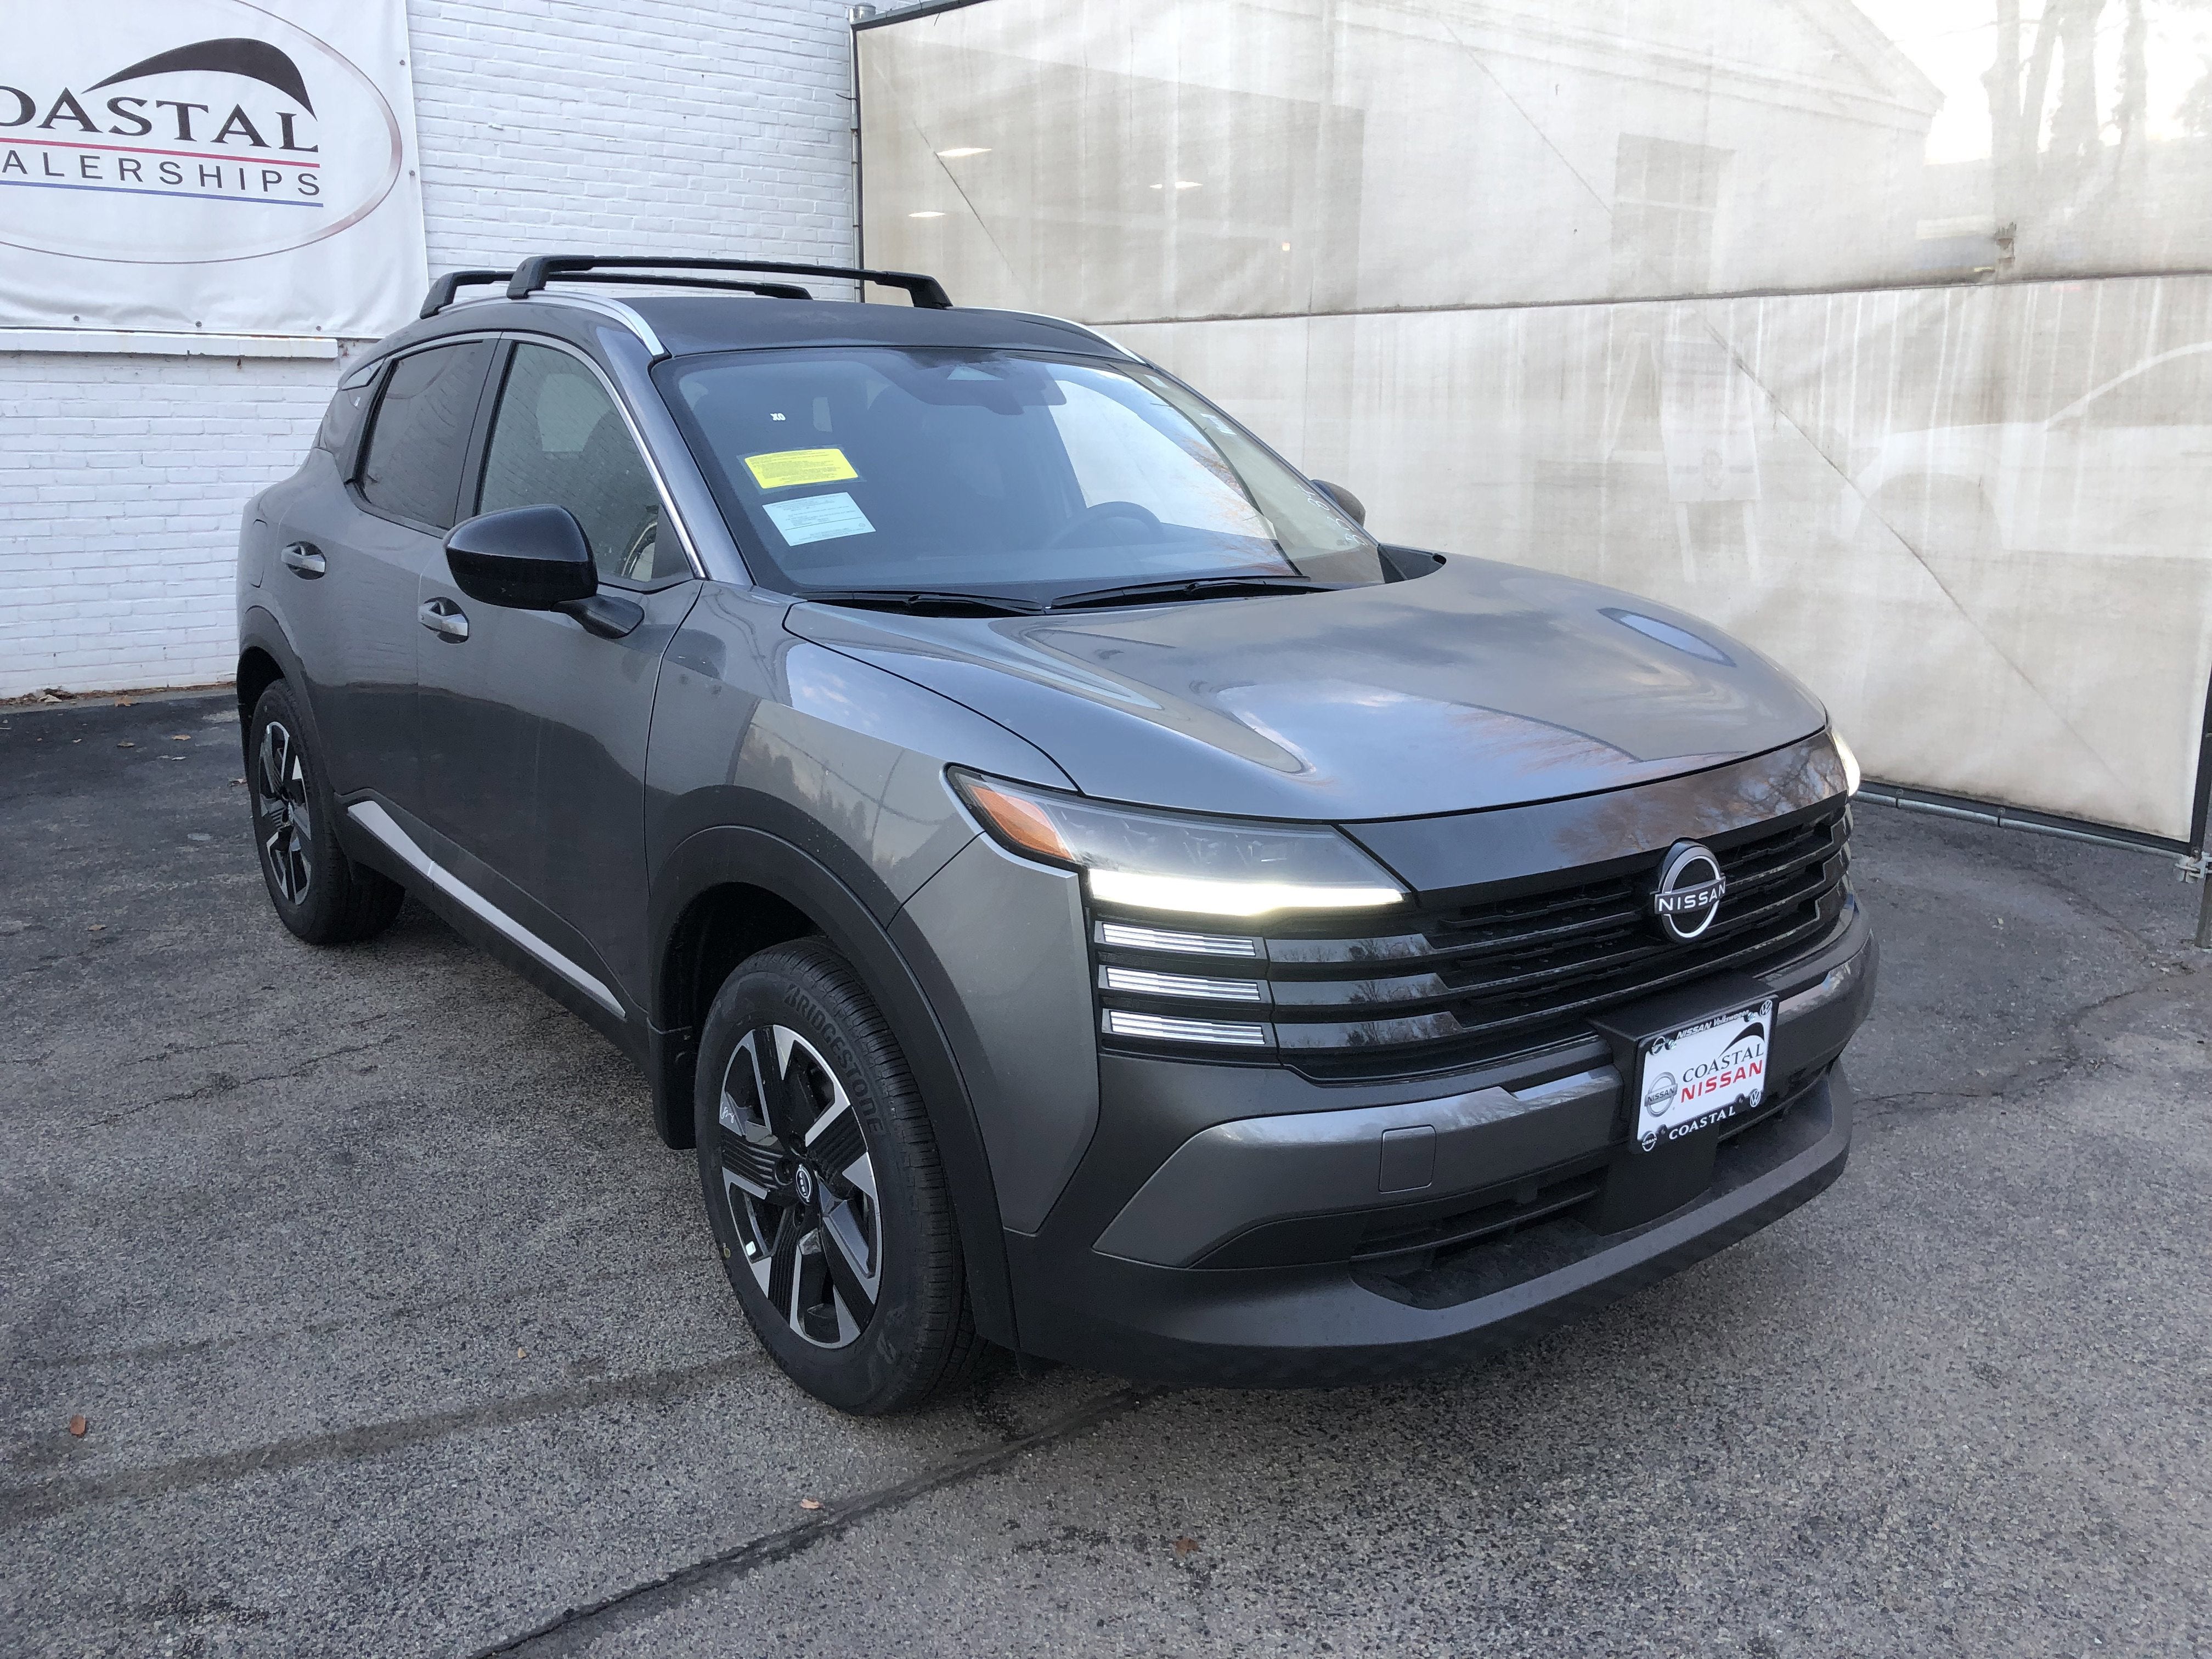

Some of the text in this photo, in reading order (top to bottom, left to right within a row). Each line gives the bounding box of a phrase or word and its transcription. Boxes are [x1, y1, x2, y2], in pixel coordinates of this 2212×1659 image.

[0, 86, 318, 153] OASTAL
[2, 149, 320, 196] ALERSHIPS
[1658, 881, 1725, 911] NISSAN
[1677, 1022, 1712, 1040] NISSAN
[784, 984, 884, 1133] BRIDGESTONE
[1683, 1043, 1764, 1083] COASTAL
[1647, 1086, 1675, 1102] NISSAN
[1681, 1059, 1763, 1103] NISSAN
[1669, 1106, 1736, 1139] COASTAL
